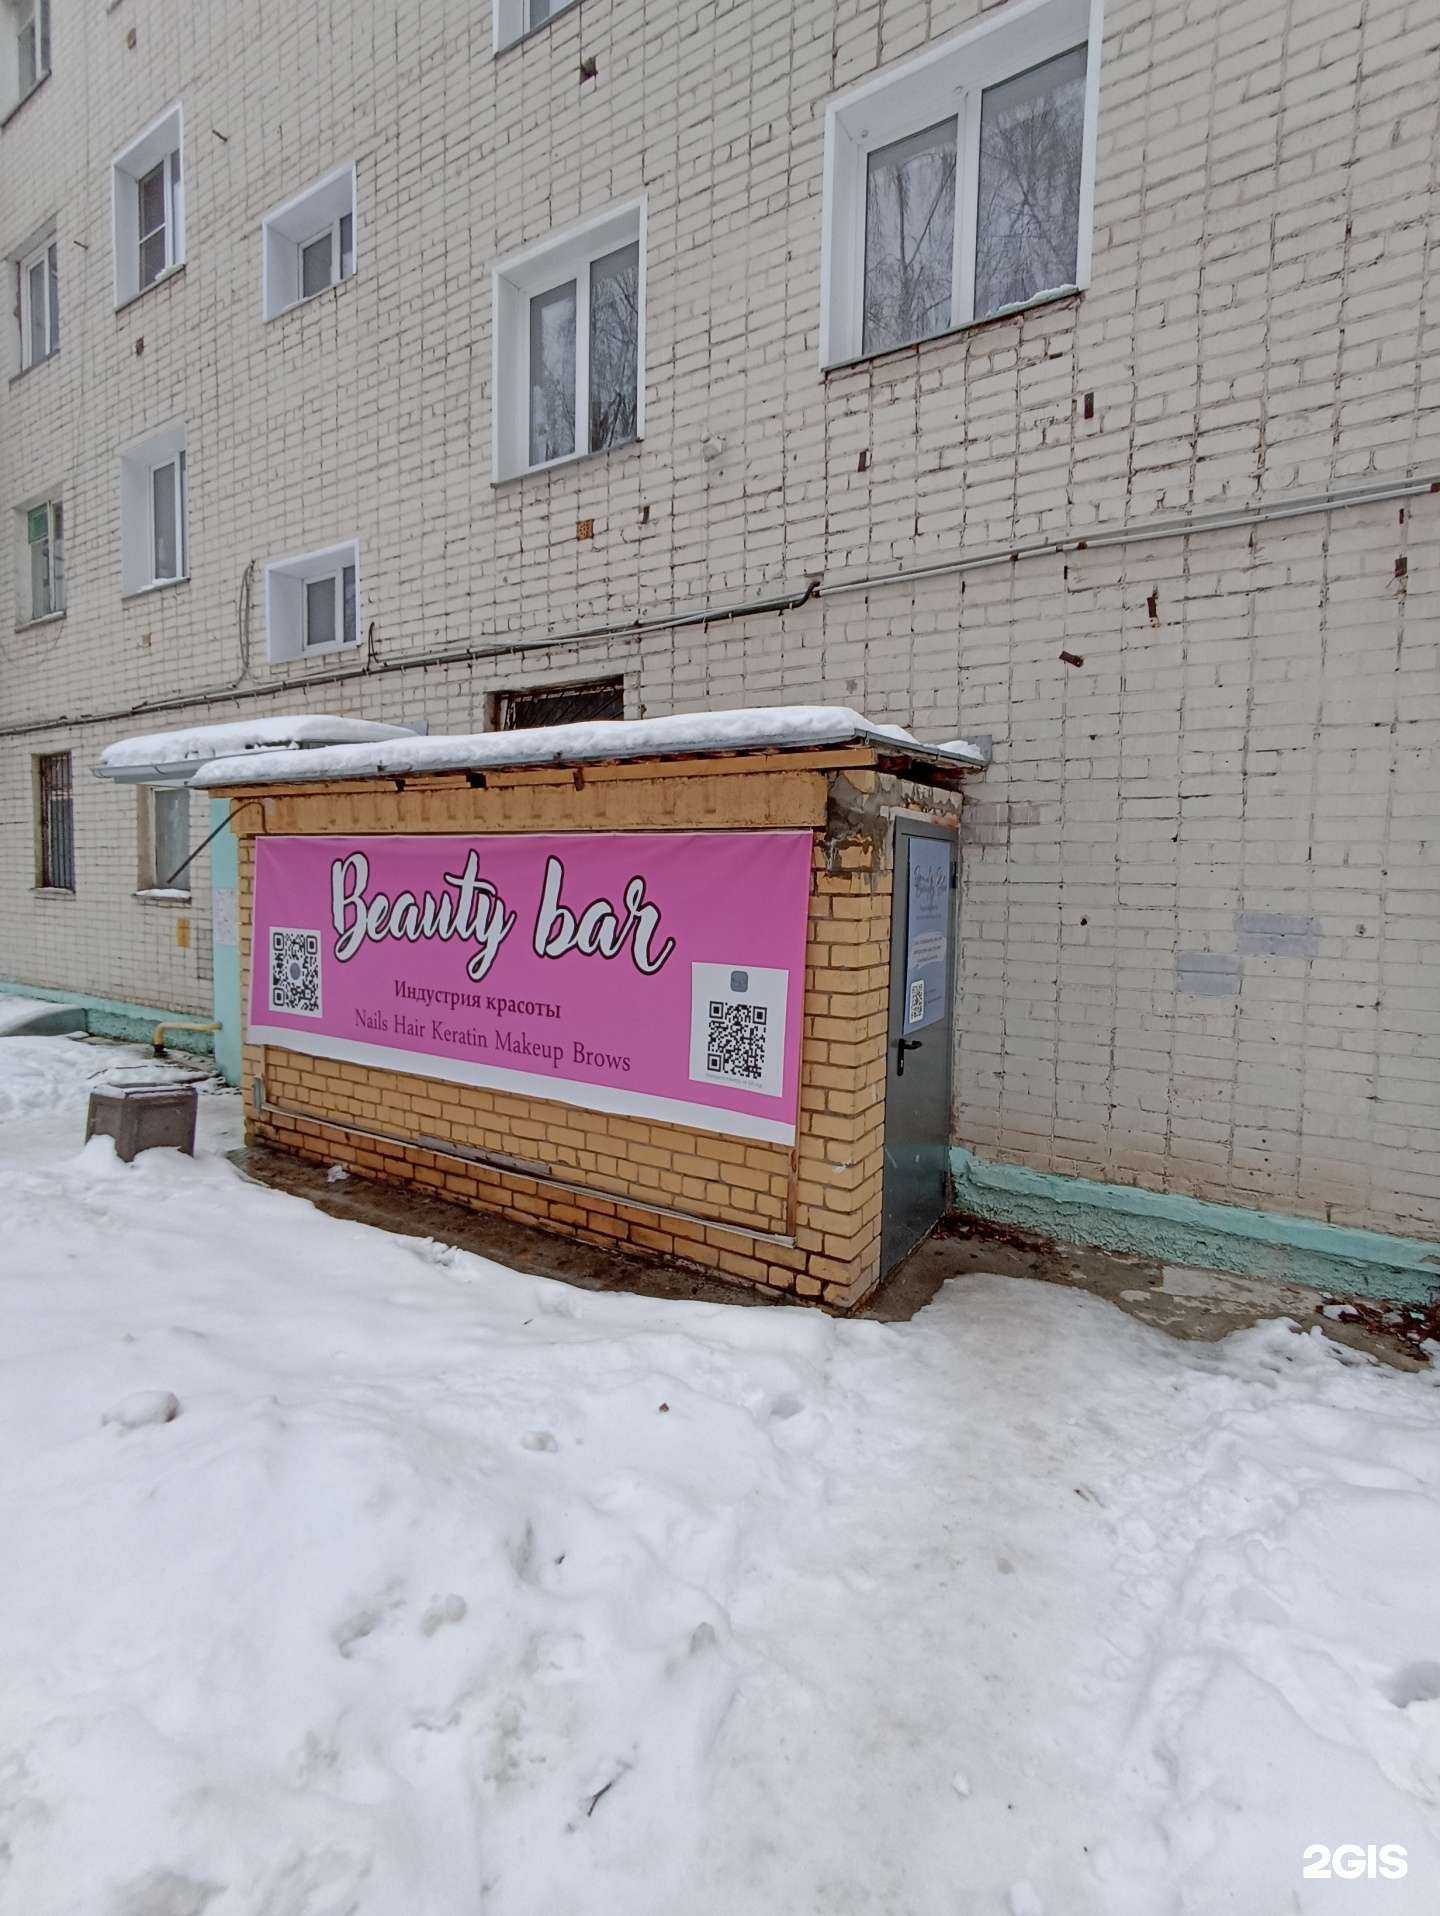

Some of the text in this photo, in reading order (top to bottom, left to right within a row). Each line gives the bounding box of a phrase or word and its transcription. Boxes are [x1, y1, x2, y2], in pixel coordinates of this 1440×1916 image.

[331, 849, 676, 982] Beauty bar
[394, 980, 561, 1019] Индустрия красоты
[355, 1008, 631, 1072] Nails Hair Keratin Makeup Brows
